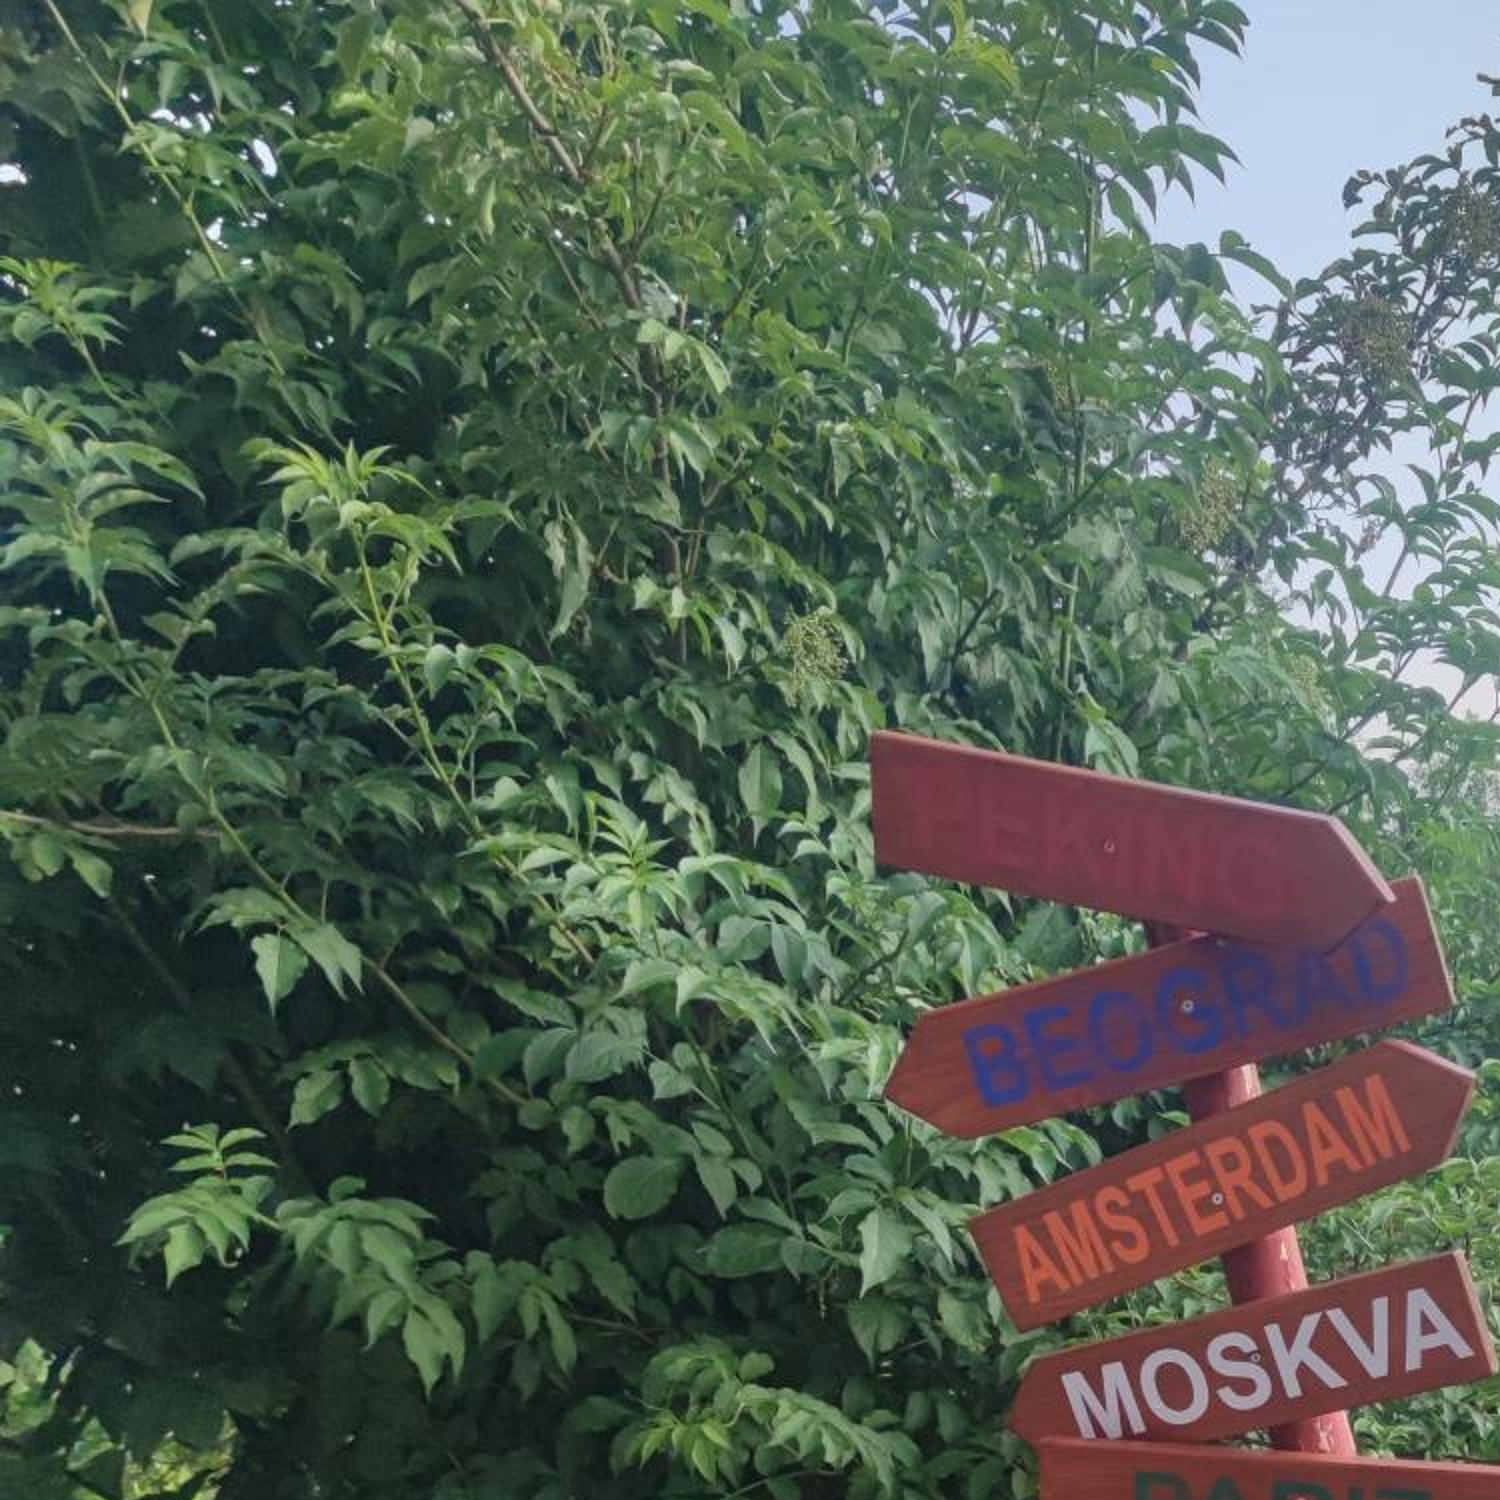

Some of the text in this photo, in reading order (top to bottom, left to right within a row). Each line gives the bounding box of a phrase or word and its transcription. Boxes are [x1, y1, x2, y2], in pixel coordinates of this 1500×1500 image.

[963, 916, 1408, 1108] BEOGRAD
[1013, 1073, 1411, 1302] AMSTERDAM
[1061, 1287, 1473, 1440] MOSKVA
